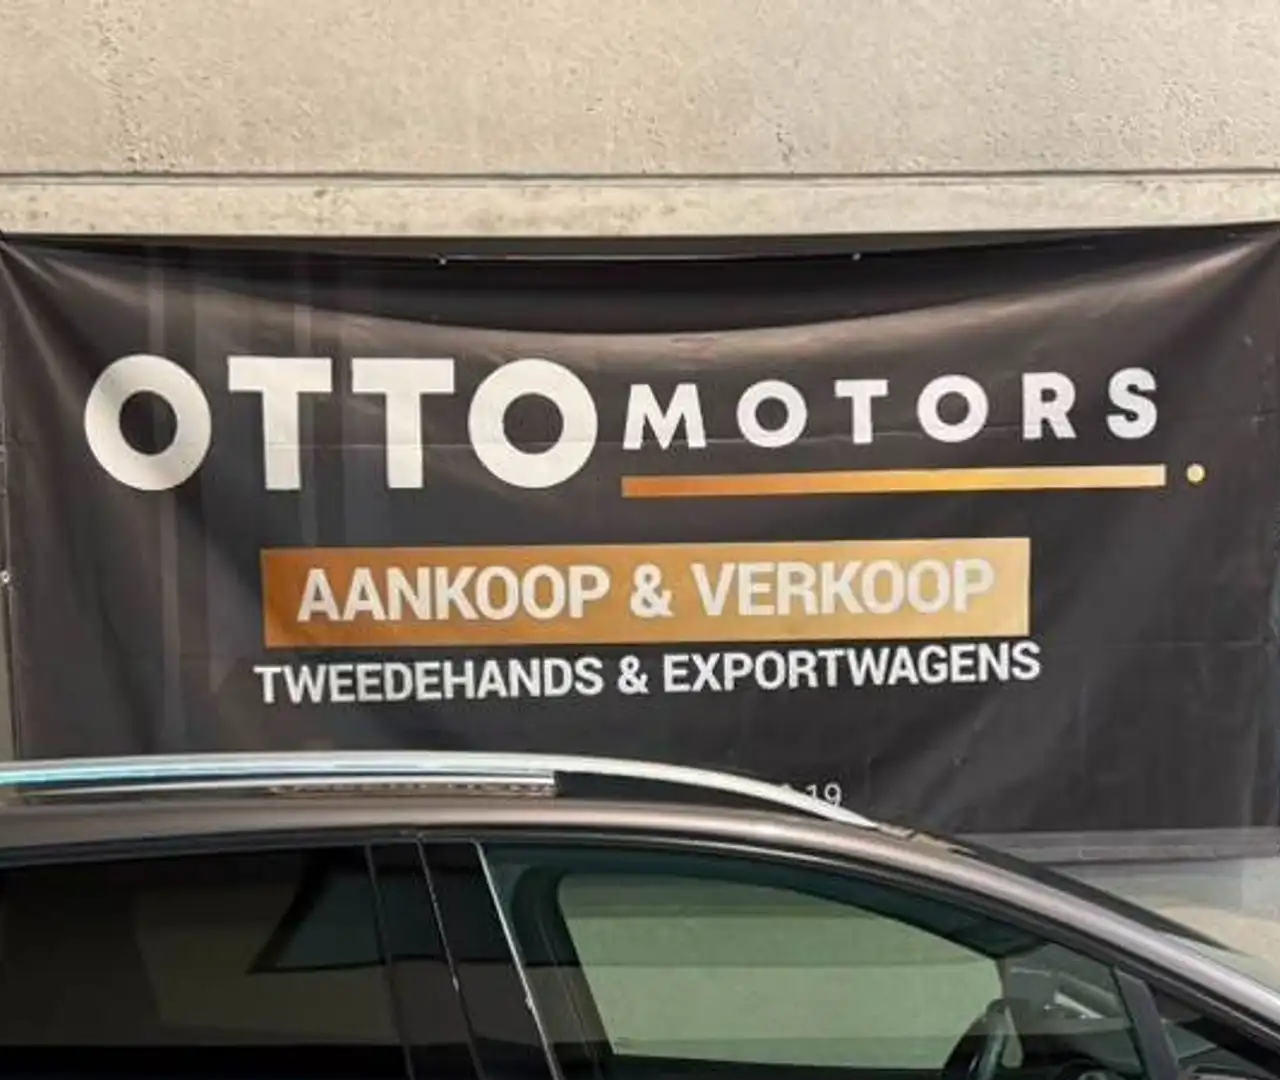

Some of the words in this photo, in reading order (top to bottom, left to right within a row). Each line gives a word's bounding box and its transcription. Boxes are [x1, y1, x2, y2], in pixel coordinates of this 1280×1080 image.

[83, 354, 598, 491] OTTO
[622, 367, 1158, 450] MOTORS
[297, 564, 612, 622] AANKOOP
[629, 564, 672, 619] &
[692, 558, 996, 618] VERKOOP
[253, 656, 604, 704] TWEEDEHANDS
[617, 654, 649, 695] &
[663, 640, 1041, 693] EXPORTWAGENS
